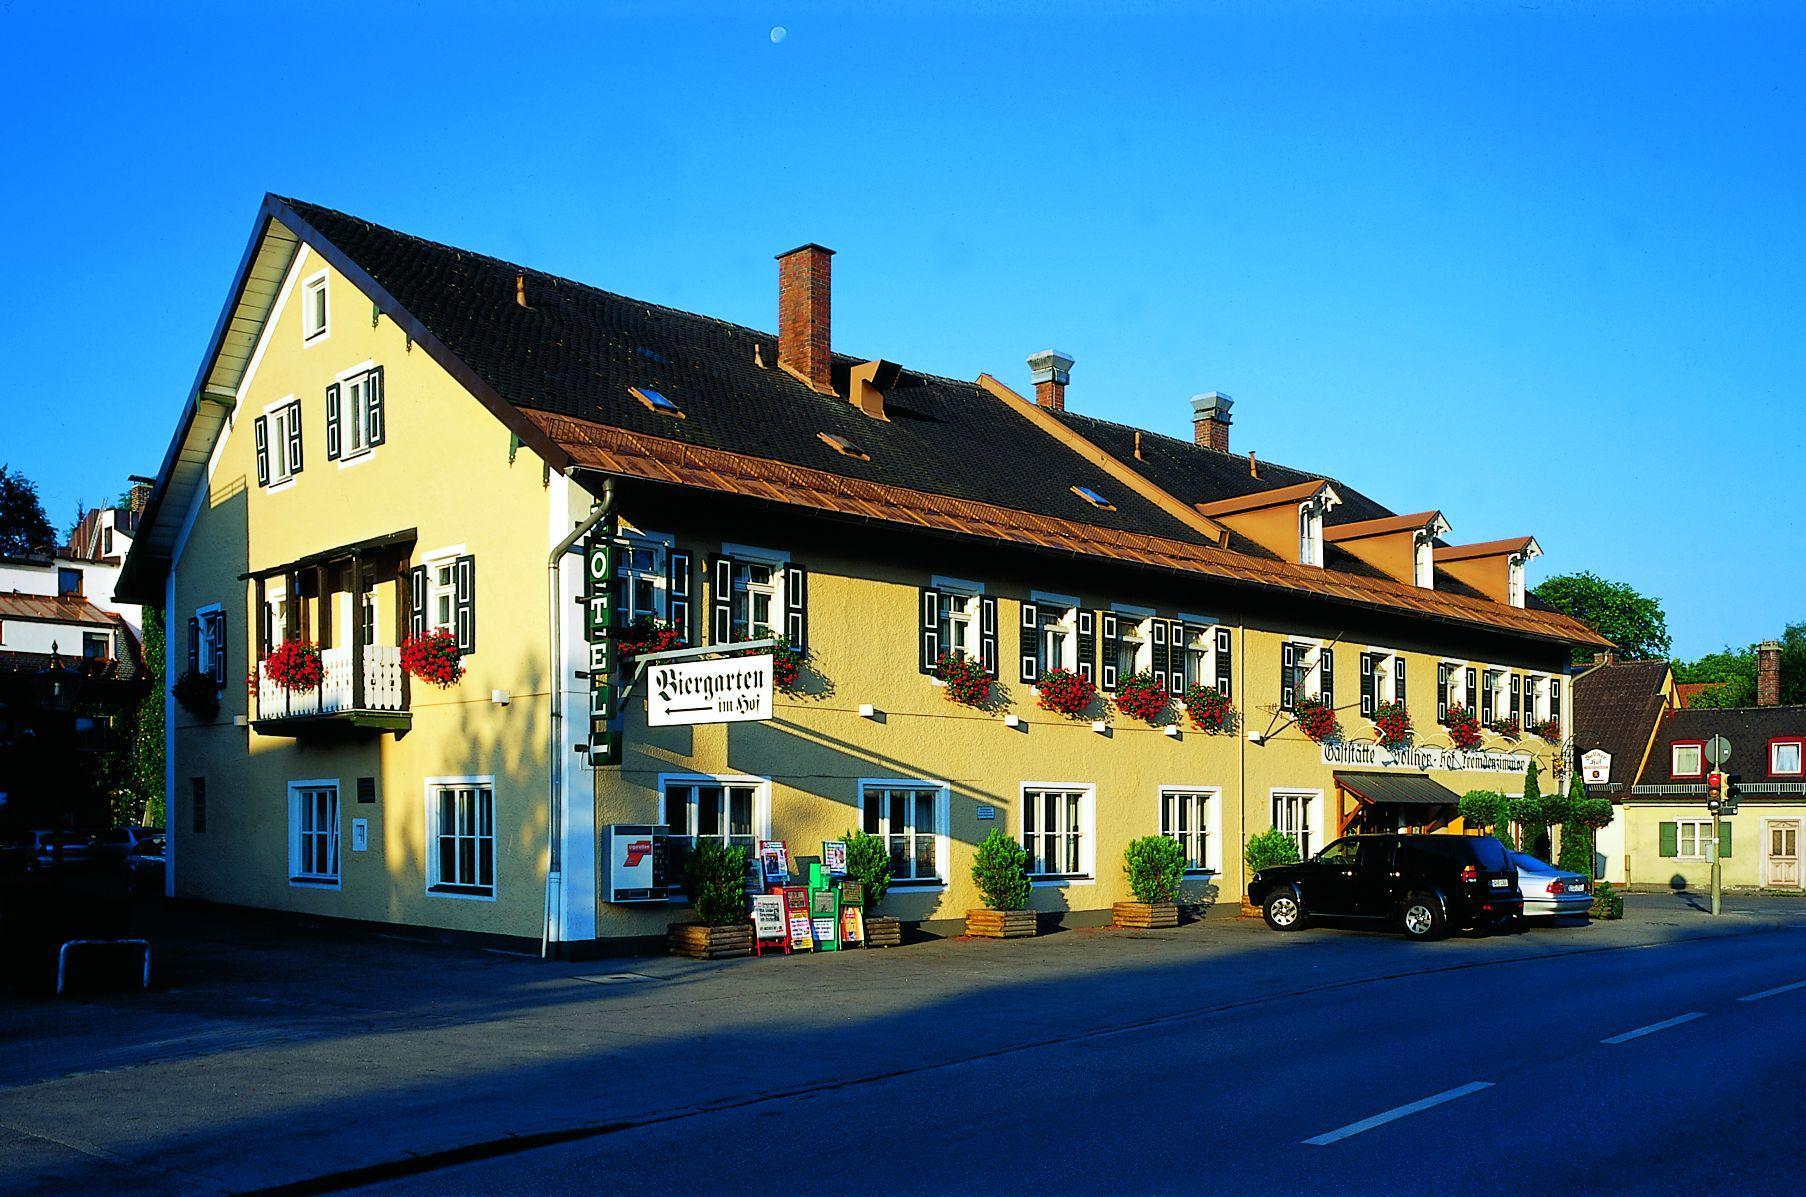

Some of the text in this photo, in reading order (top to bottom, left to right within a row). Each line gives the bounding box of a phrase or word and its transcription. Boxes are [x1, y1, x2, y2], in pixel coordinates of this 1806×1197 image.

[590, 506, 607, 716] OTEL
[656, 668, 764, 701] Biergarten
[718, 694, 761, 716] im Hof
